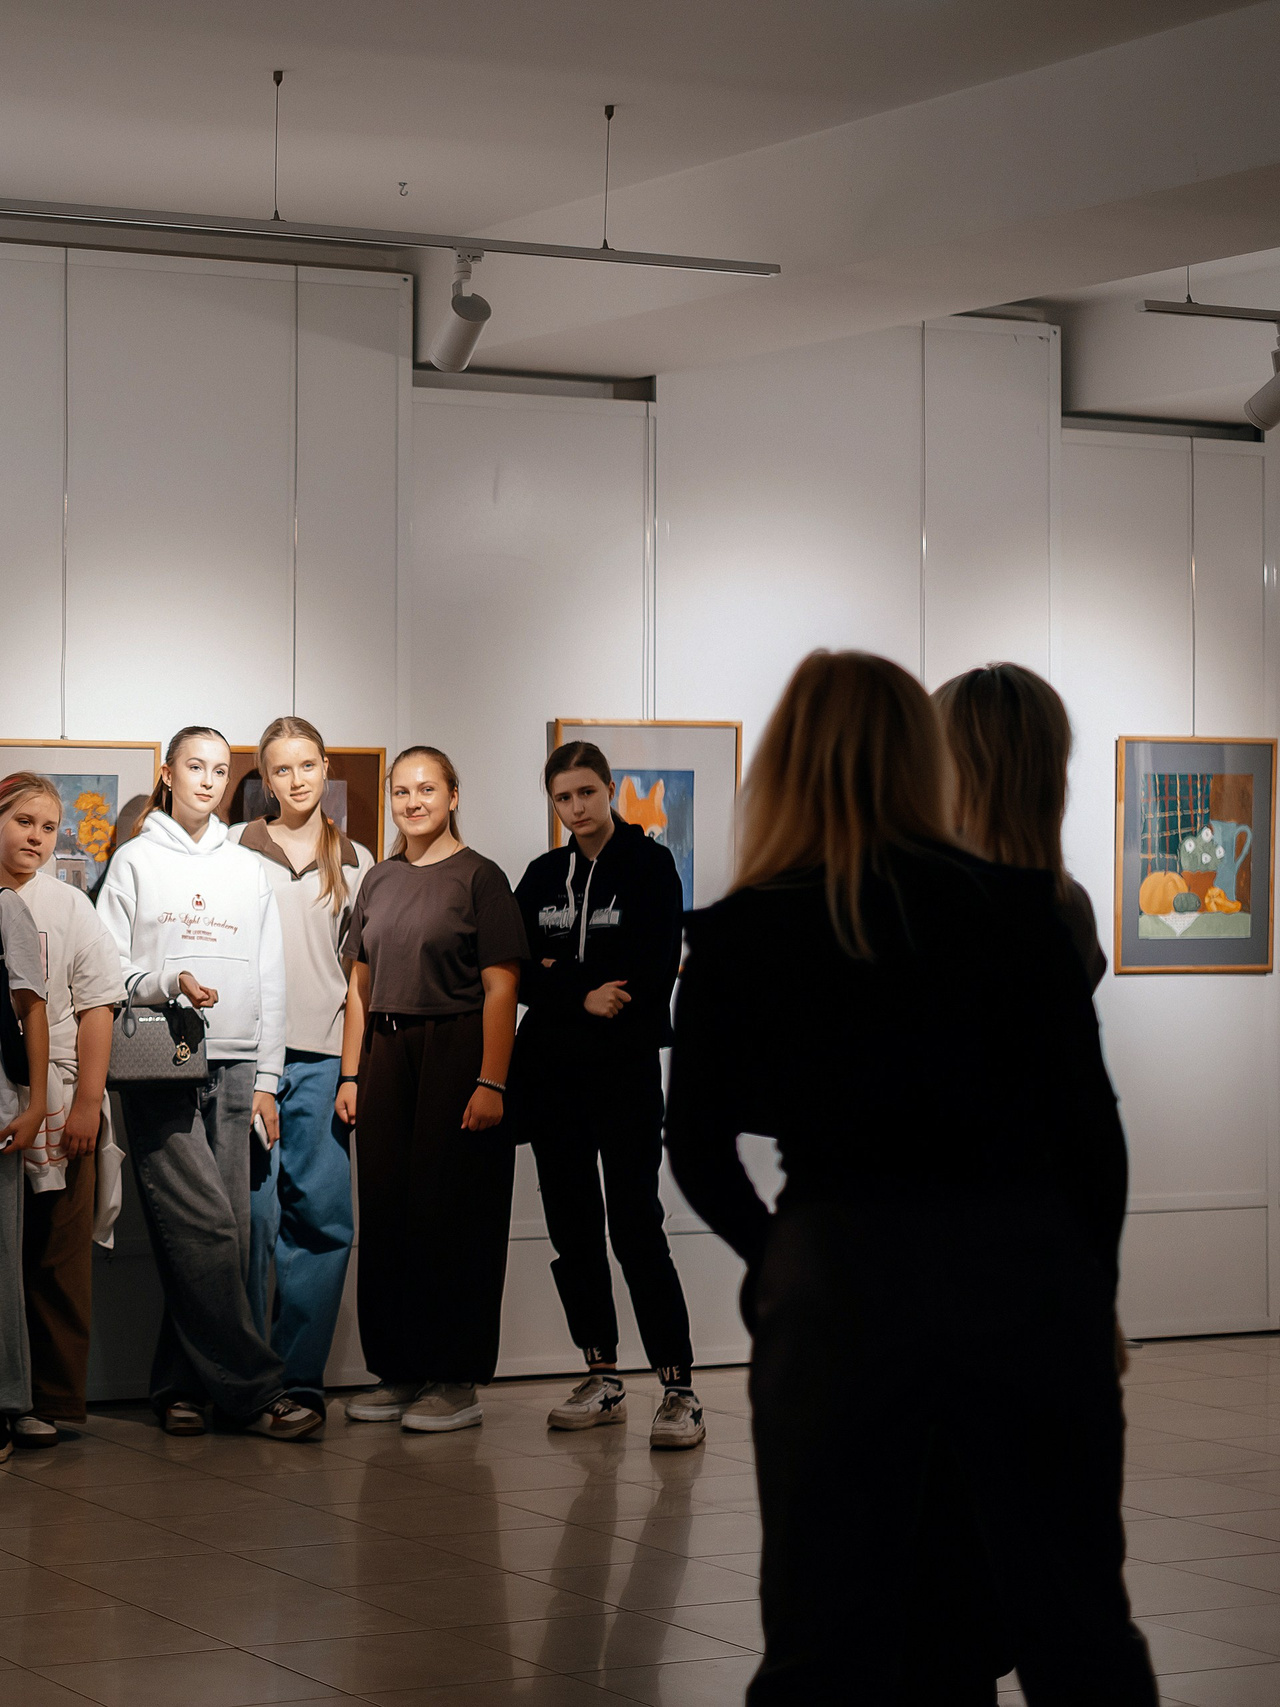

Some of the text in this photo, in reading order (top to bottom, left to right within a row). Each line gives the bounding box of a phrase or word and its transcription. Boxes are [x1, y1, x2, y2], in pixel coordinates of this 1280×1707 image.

[157, 911, 177, 924] The
[178, 912, 201, 928] Light
[202, 916, 239, 935] Academy
